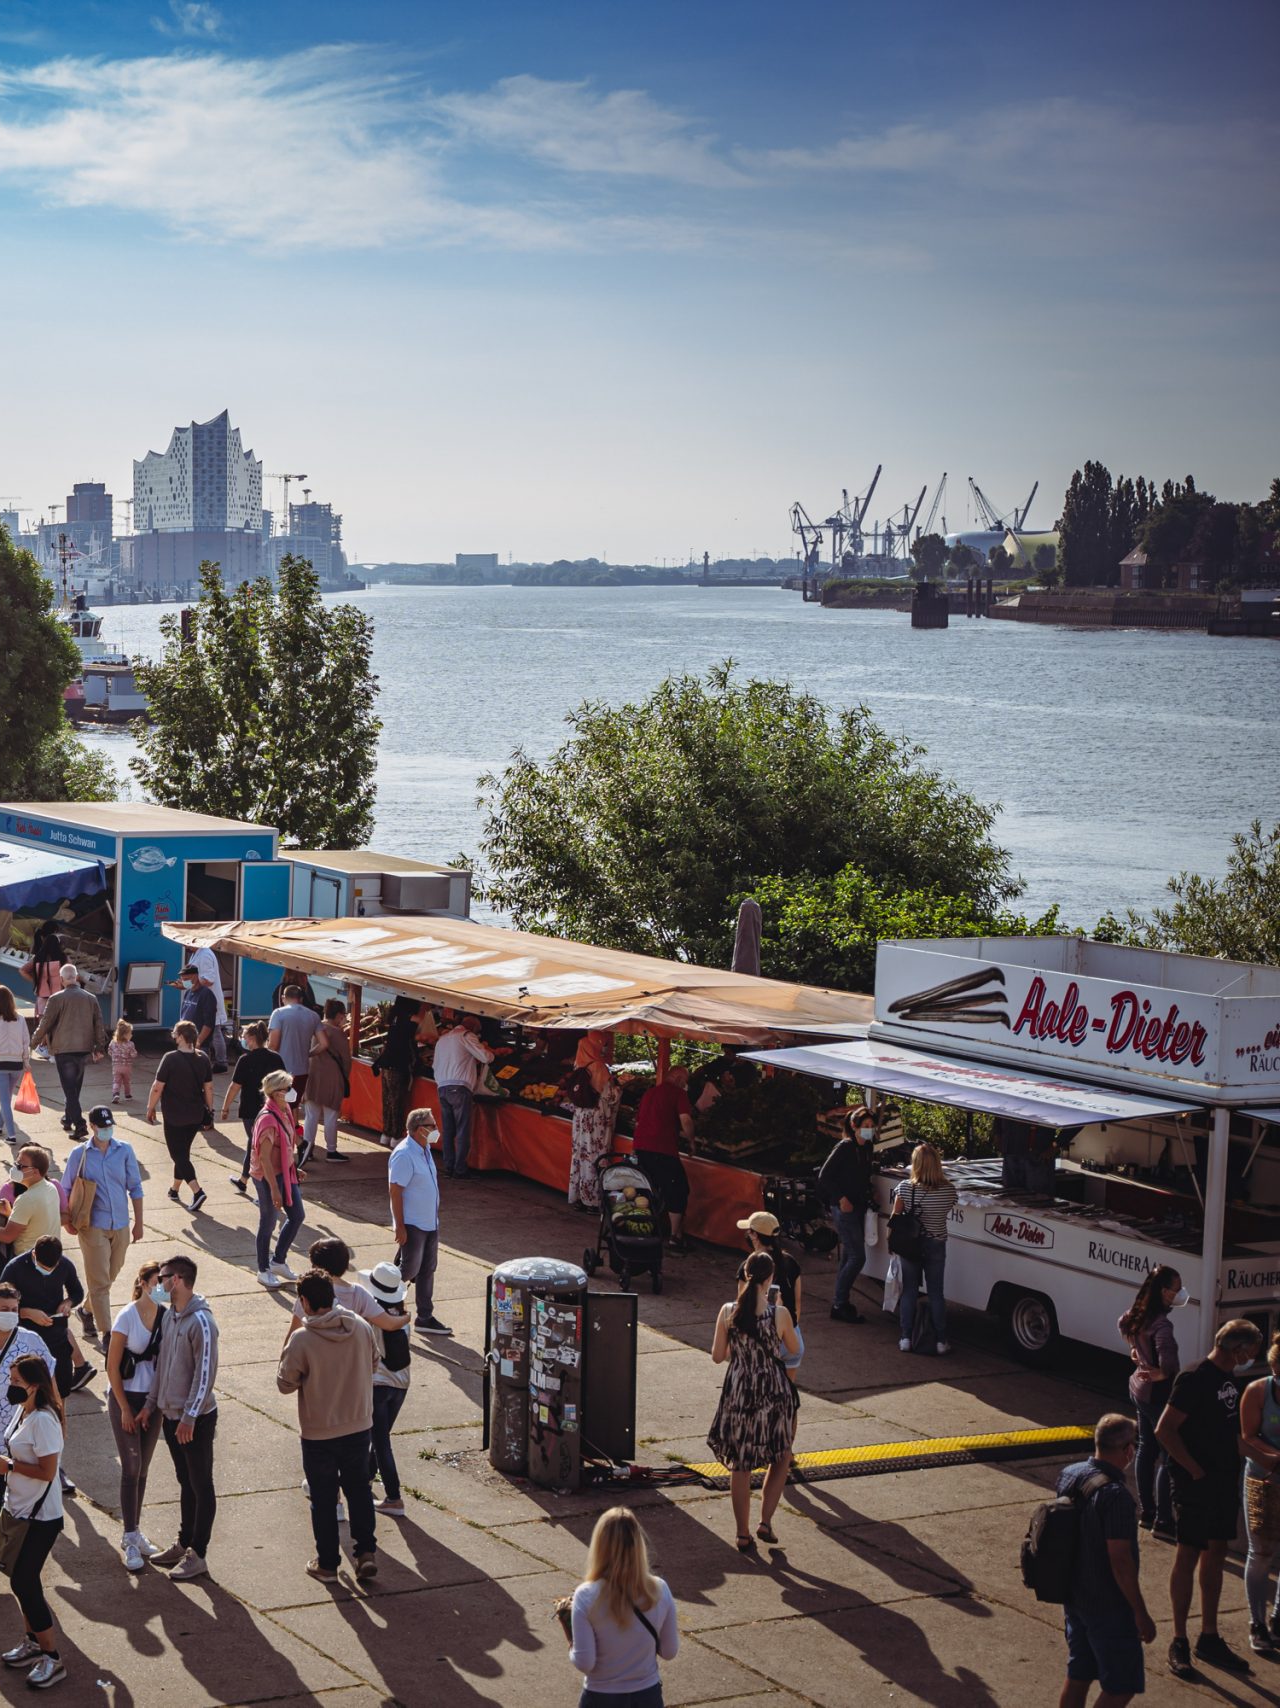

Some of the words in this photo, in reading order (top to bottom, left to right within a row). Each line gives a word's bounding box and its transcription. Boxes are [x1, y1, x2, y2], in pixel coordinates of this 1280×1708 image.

[49, 829, 67, 843] Jutta
[68, 833, 97, 849] Schwan
[1011, 975, 1208, 1068] Aale-Dieter
[991, 1215, 1046, 1245] Aale-Dieter
